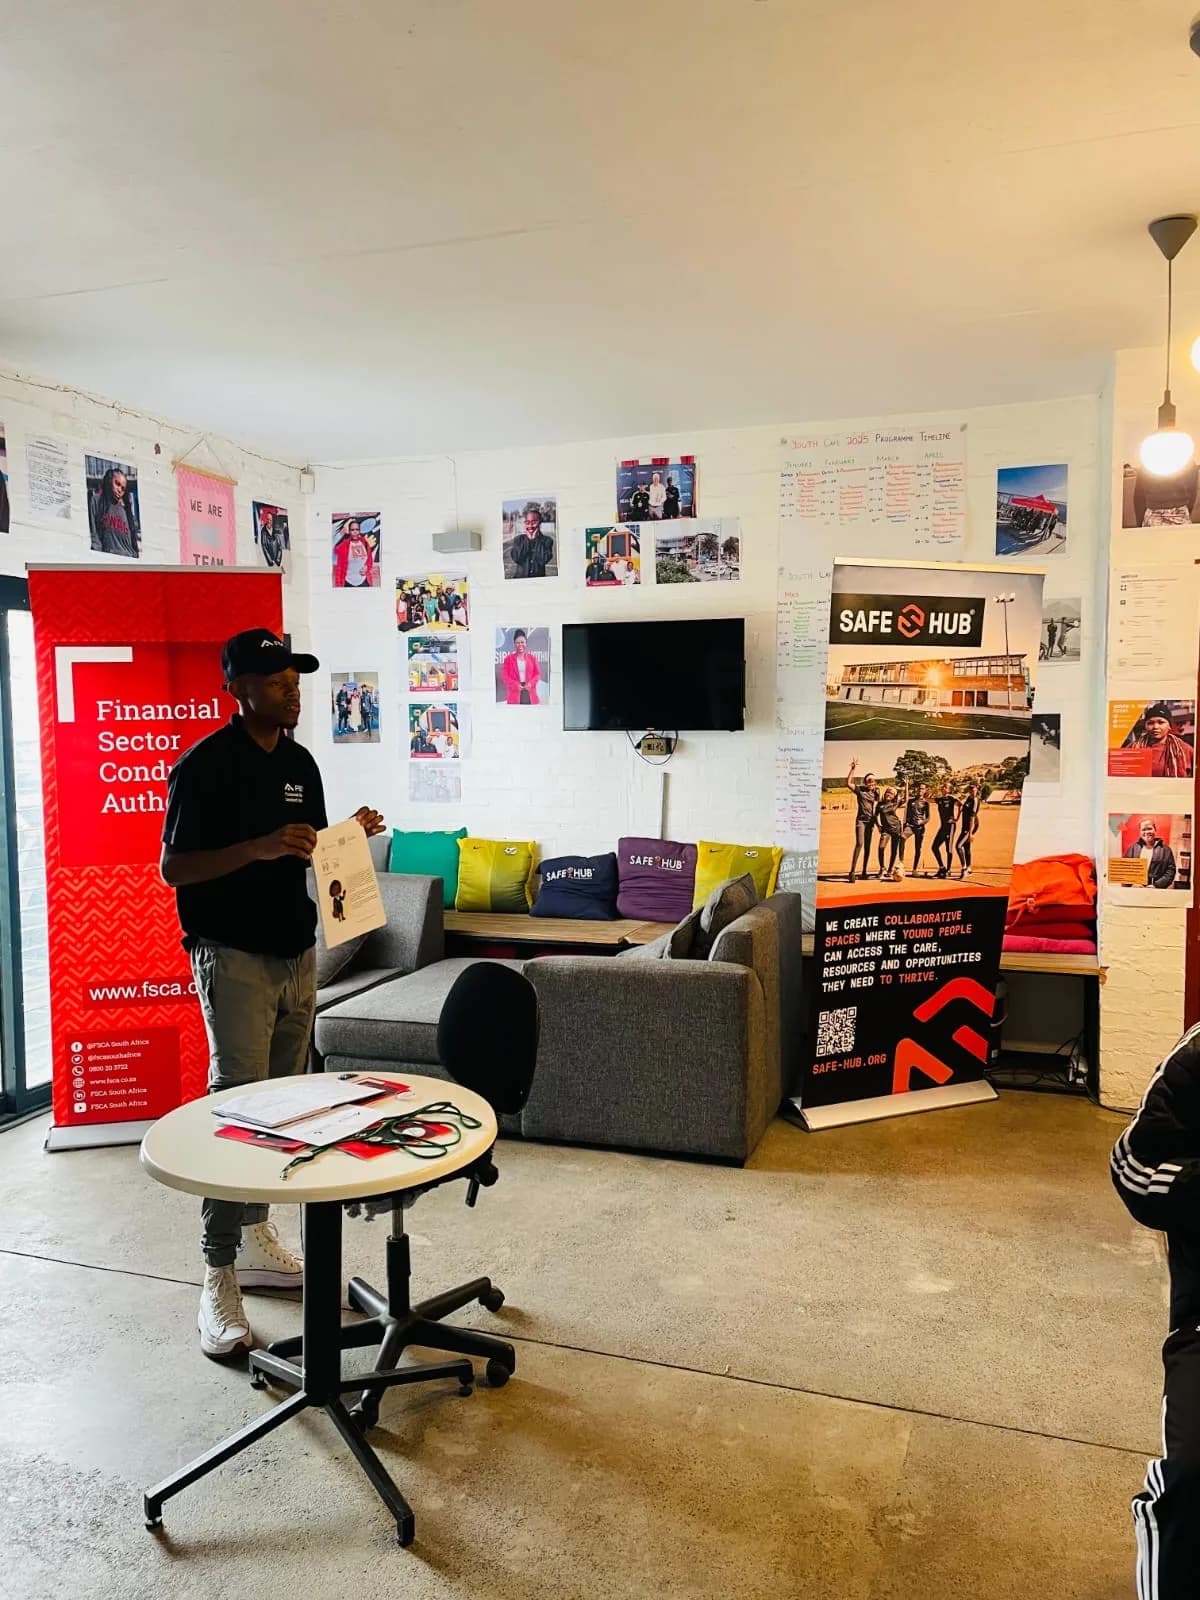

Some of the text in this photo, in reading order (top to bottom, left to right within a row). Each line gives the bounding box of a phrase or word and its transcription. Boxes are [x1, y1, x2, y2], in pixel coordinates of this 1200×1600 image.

[847, 435, 869, 446] 2025
[920, 432, 951, 441] TIMELINE
[190, 498, 223, 518] WE ARE
[839, 609, 893, 633] SAFE
[96, 698, 221, 721] Financial
[98, 731, 181, 752] Sector
[629, 855, 654, 866] SAFE
[546, 869, 567, 882] SAFE
[826, 910, 963, 932] WE CREATE COLLABORATIVE
[825, 923, 972, 947] SPACES WHERE YOUNG PEOPLE
[824, 942, 942, 963] CAN ACCESS THE CARE,
[822, 952, 982, 978] RESOURCES AND OPPORTUNITIES
[822, 971, 939, 993] THEY NEED TO THRIVE.
[812, 1053, 887, 1075] SAFE-HUB.ORG
